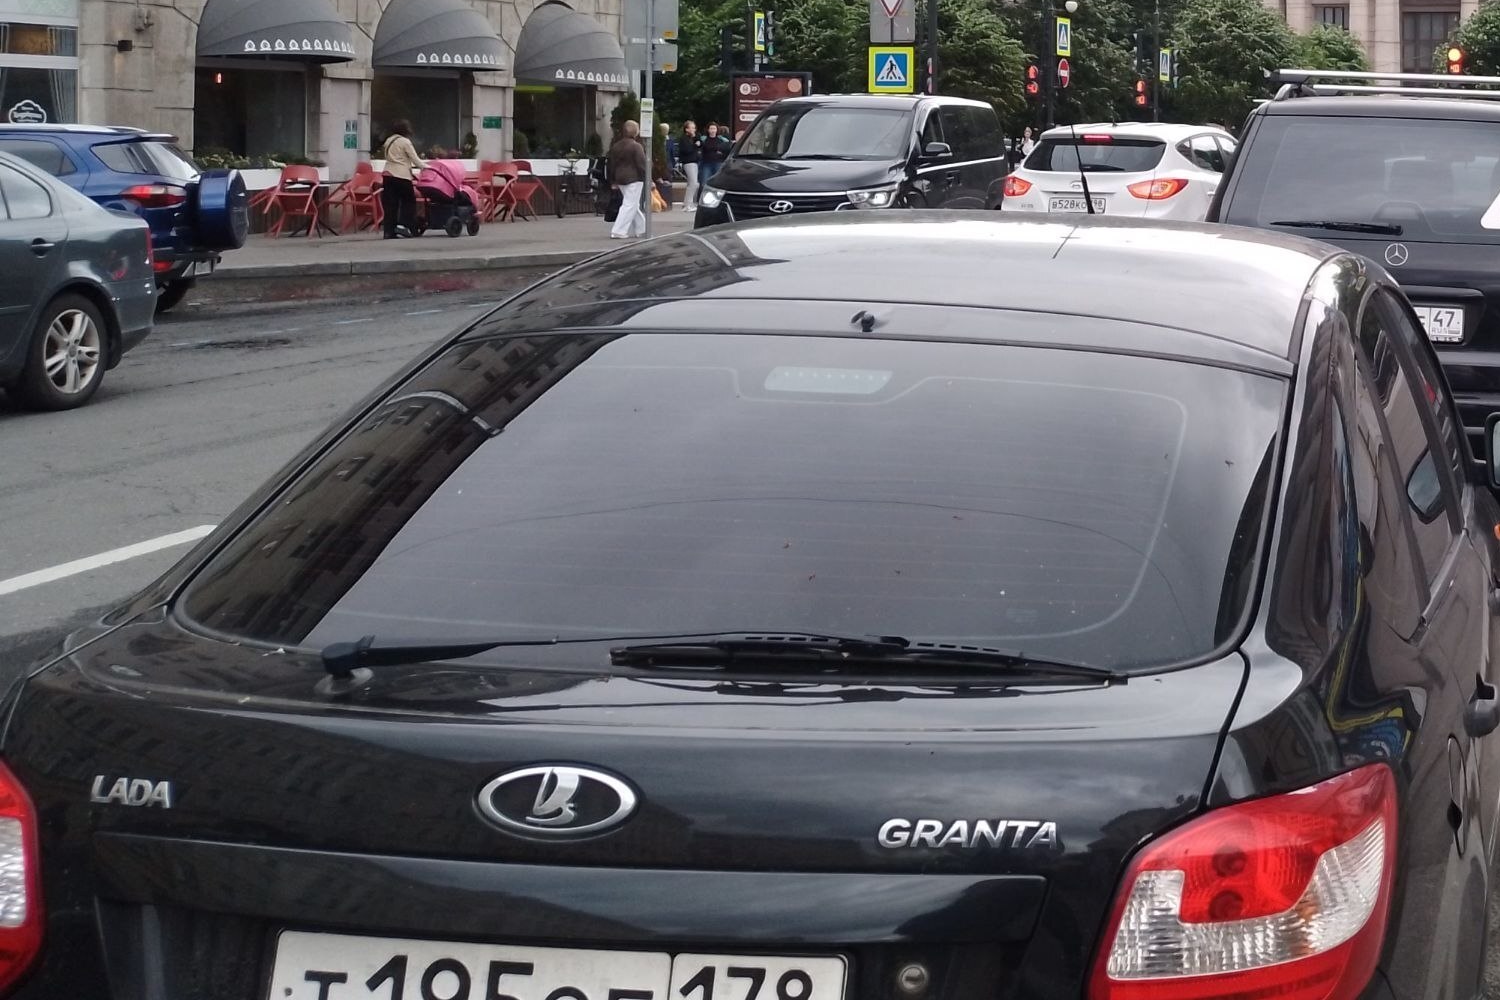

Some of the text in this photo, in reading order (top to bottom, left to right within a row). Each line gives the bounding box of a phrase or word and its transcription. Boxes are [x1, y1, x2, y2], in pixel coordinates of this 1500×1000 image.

[1433, 310, 1456, 328] 47
[90, 775, 171, 809] LADA
[878, 818, 1058, 849] GRANTA
